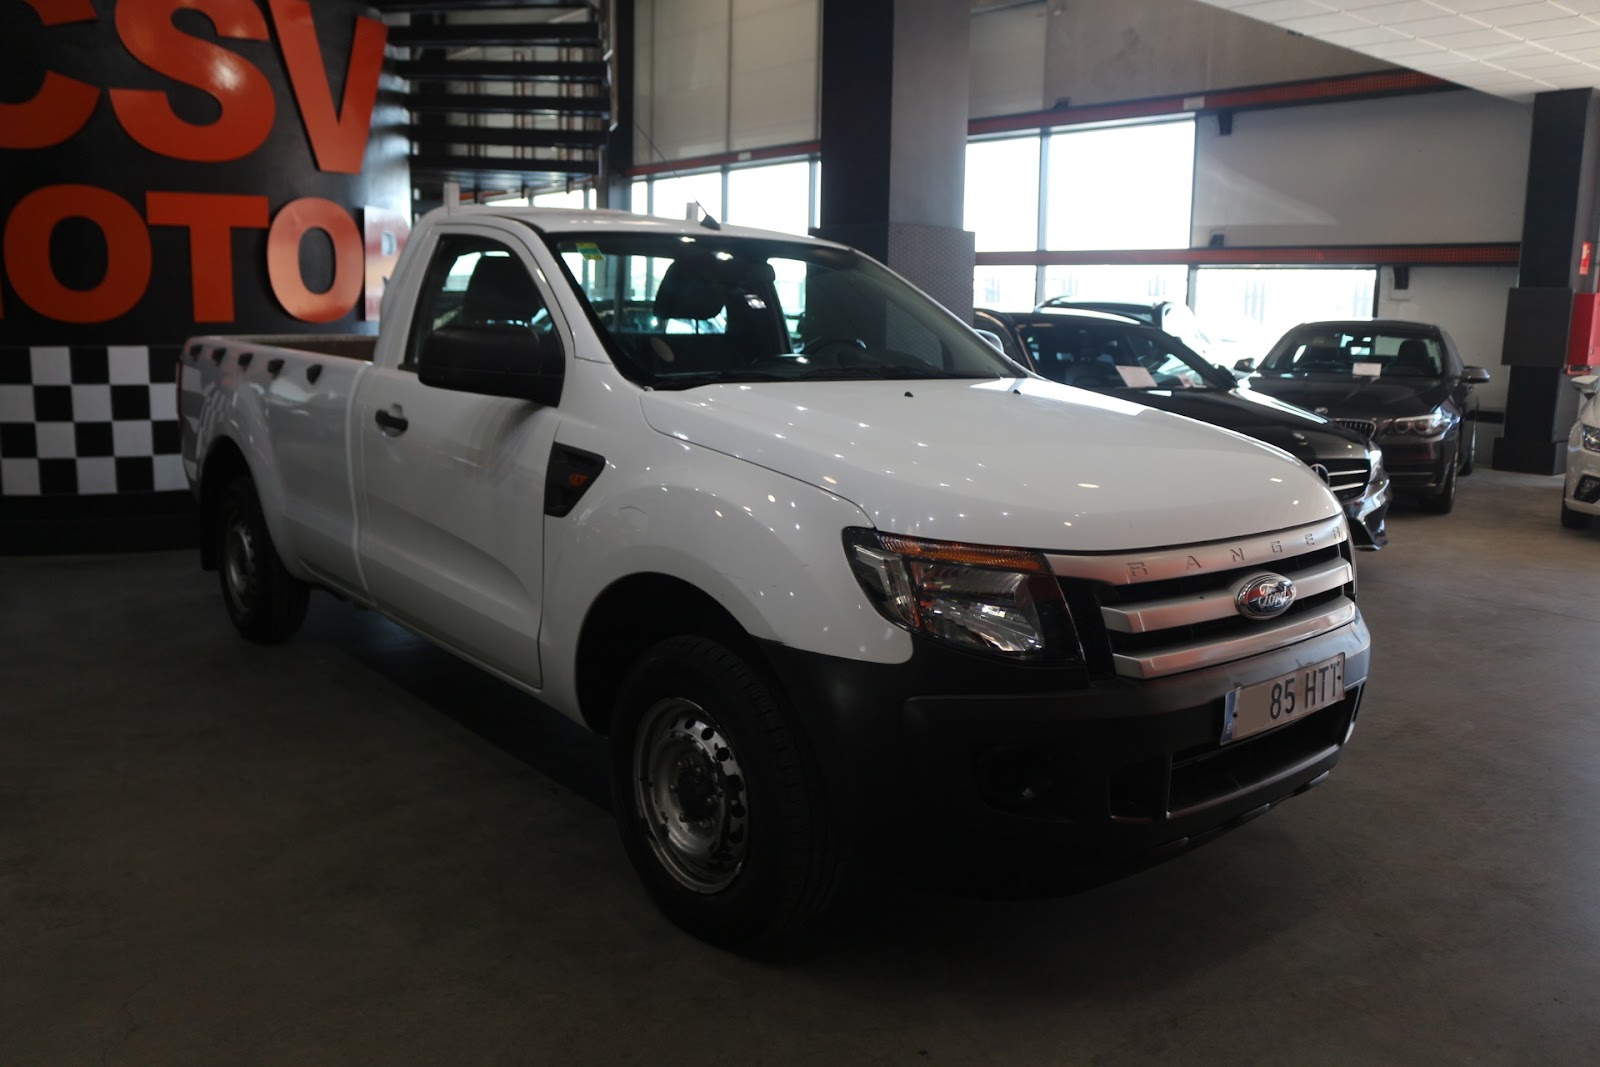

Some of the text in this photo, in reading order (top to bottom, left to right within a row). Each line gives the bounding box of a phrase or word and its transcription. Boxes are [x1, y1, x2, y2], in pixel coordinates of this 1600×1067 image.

[1127, 526, 1341, 576] RANGER
[1258, 582, 1296, 608] Ford
[1270, 677, 1295, 719] 85
